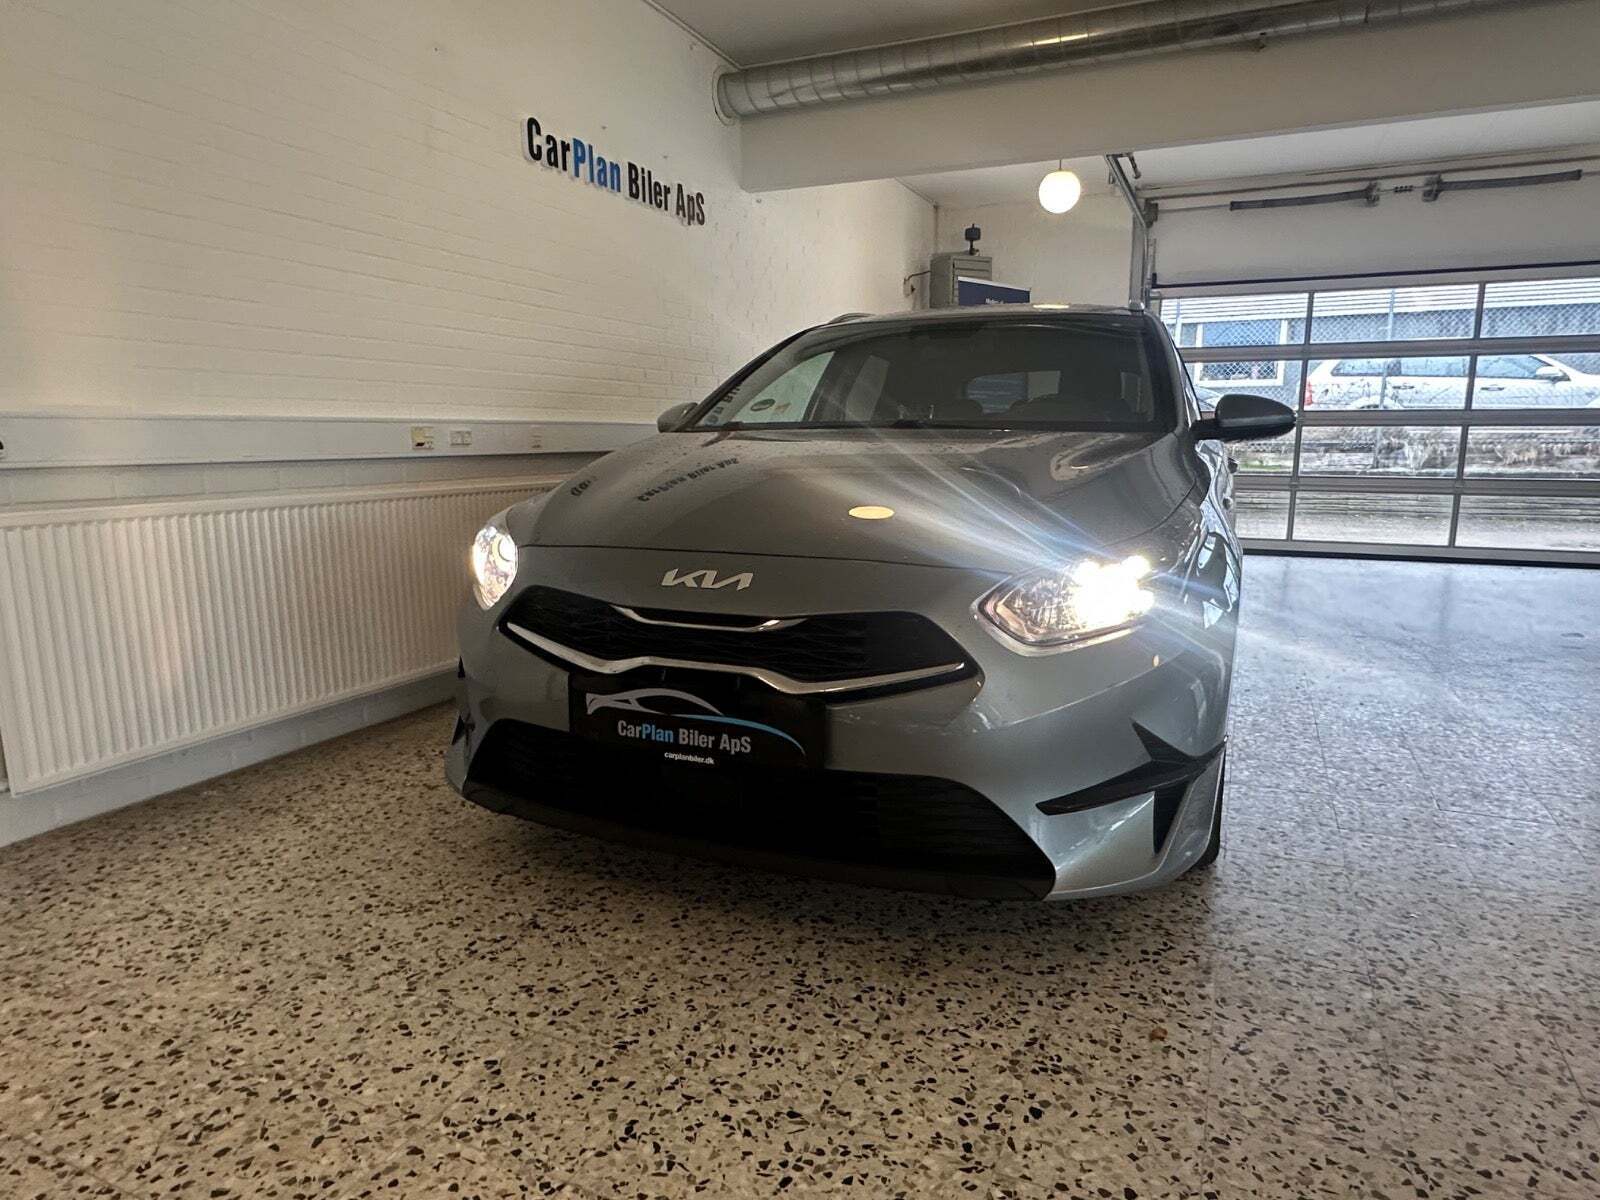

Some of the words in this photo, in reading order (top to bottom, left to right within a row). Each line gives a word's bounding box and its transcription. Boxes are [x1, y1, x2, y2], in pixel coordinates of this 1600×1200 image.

[526, 116, 621, 193] CarPlan
[627, 161, 671, 211] Biler
[675, 183, 705, 226] ApS
[617, 719, 675, 743] CarPlan
[678, 728, 716, 749] Biler
[719, 734, 751, 755] ApS
